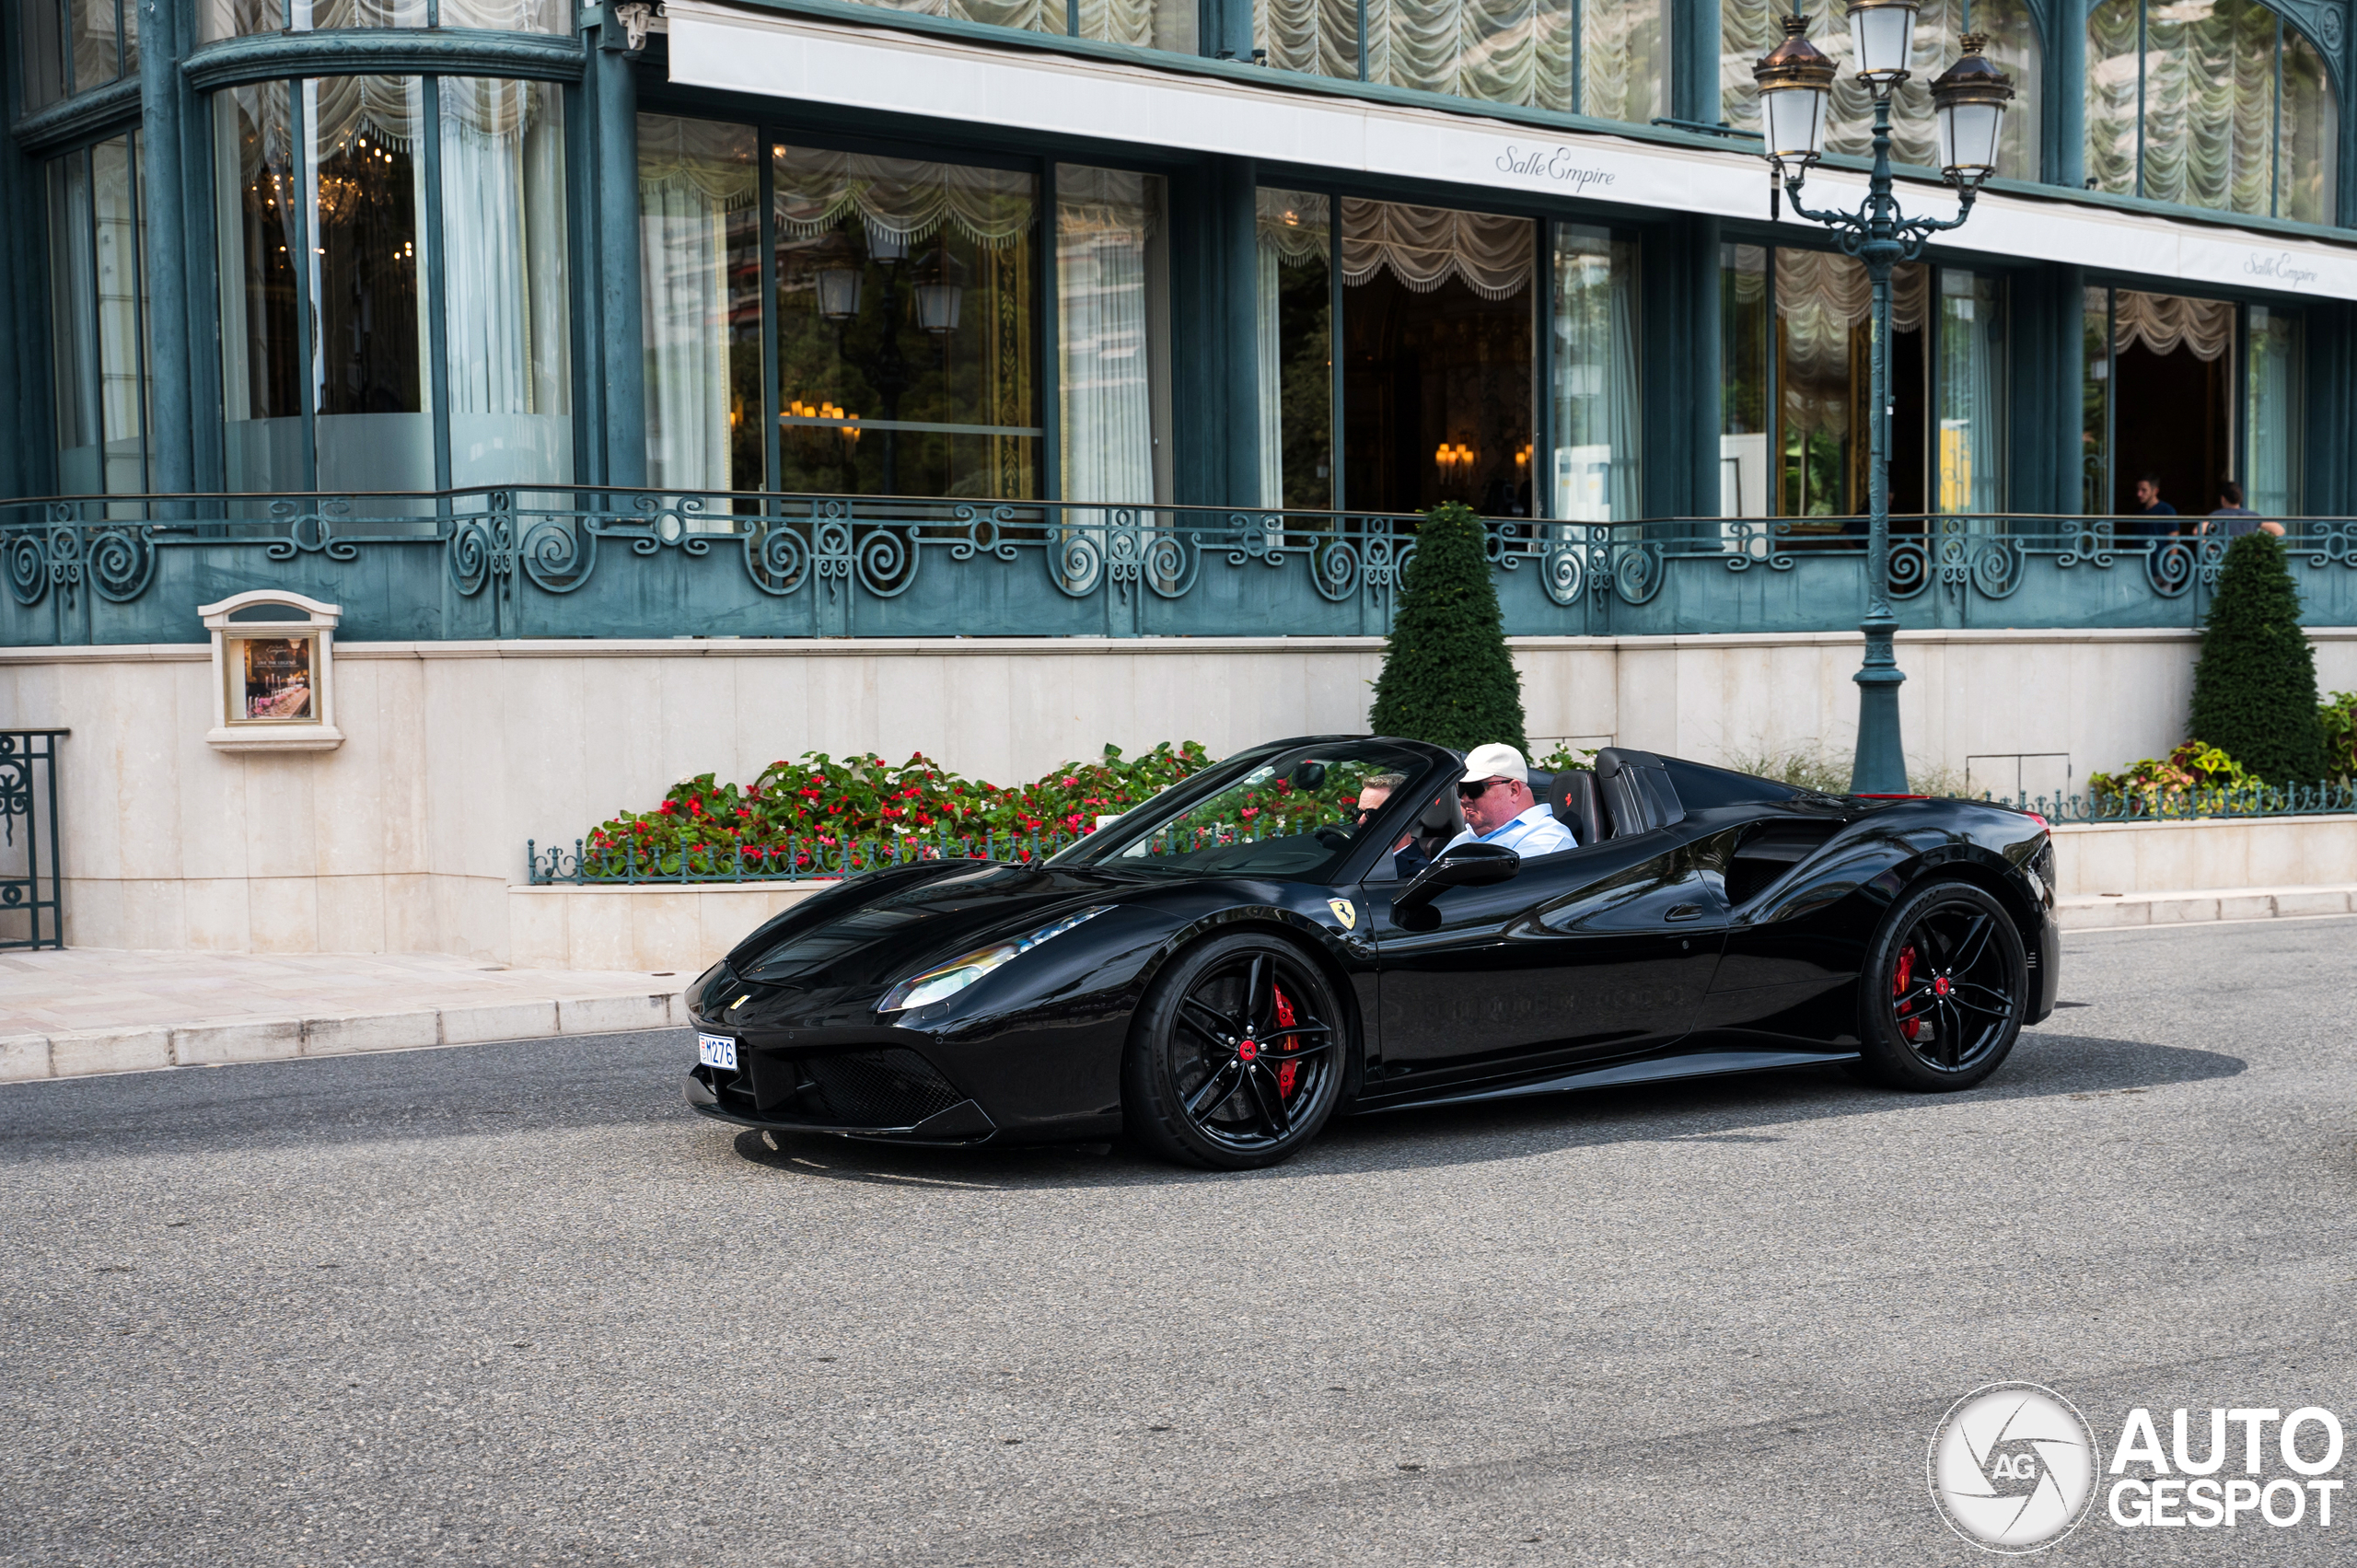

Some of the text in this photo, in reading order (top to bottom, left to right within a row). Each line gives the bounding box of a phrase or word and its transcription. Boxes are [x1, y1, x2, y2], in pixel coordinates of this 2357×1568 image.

[1495, 145, 1616, 193] Salle Empire
[2243, 251, 2318, 288] Salle Empire
[705, 1039, 734, 1065] M276
